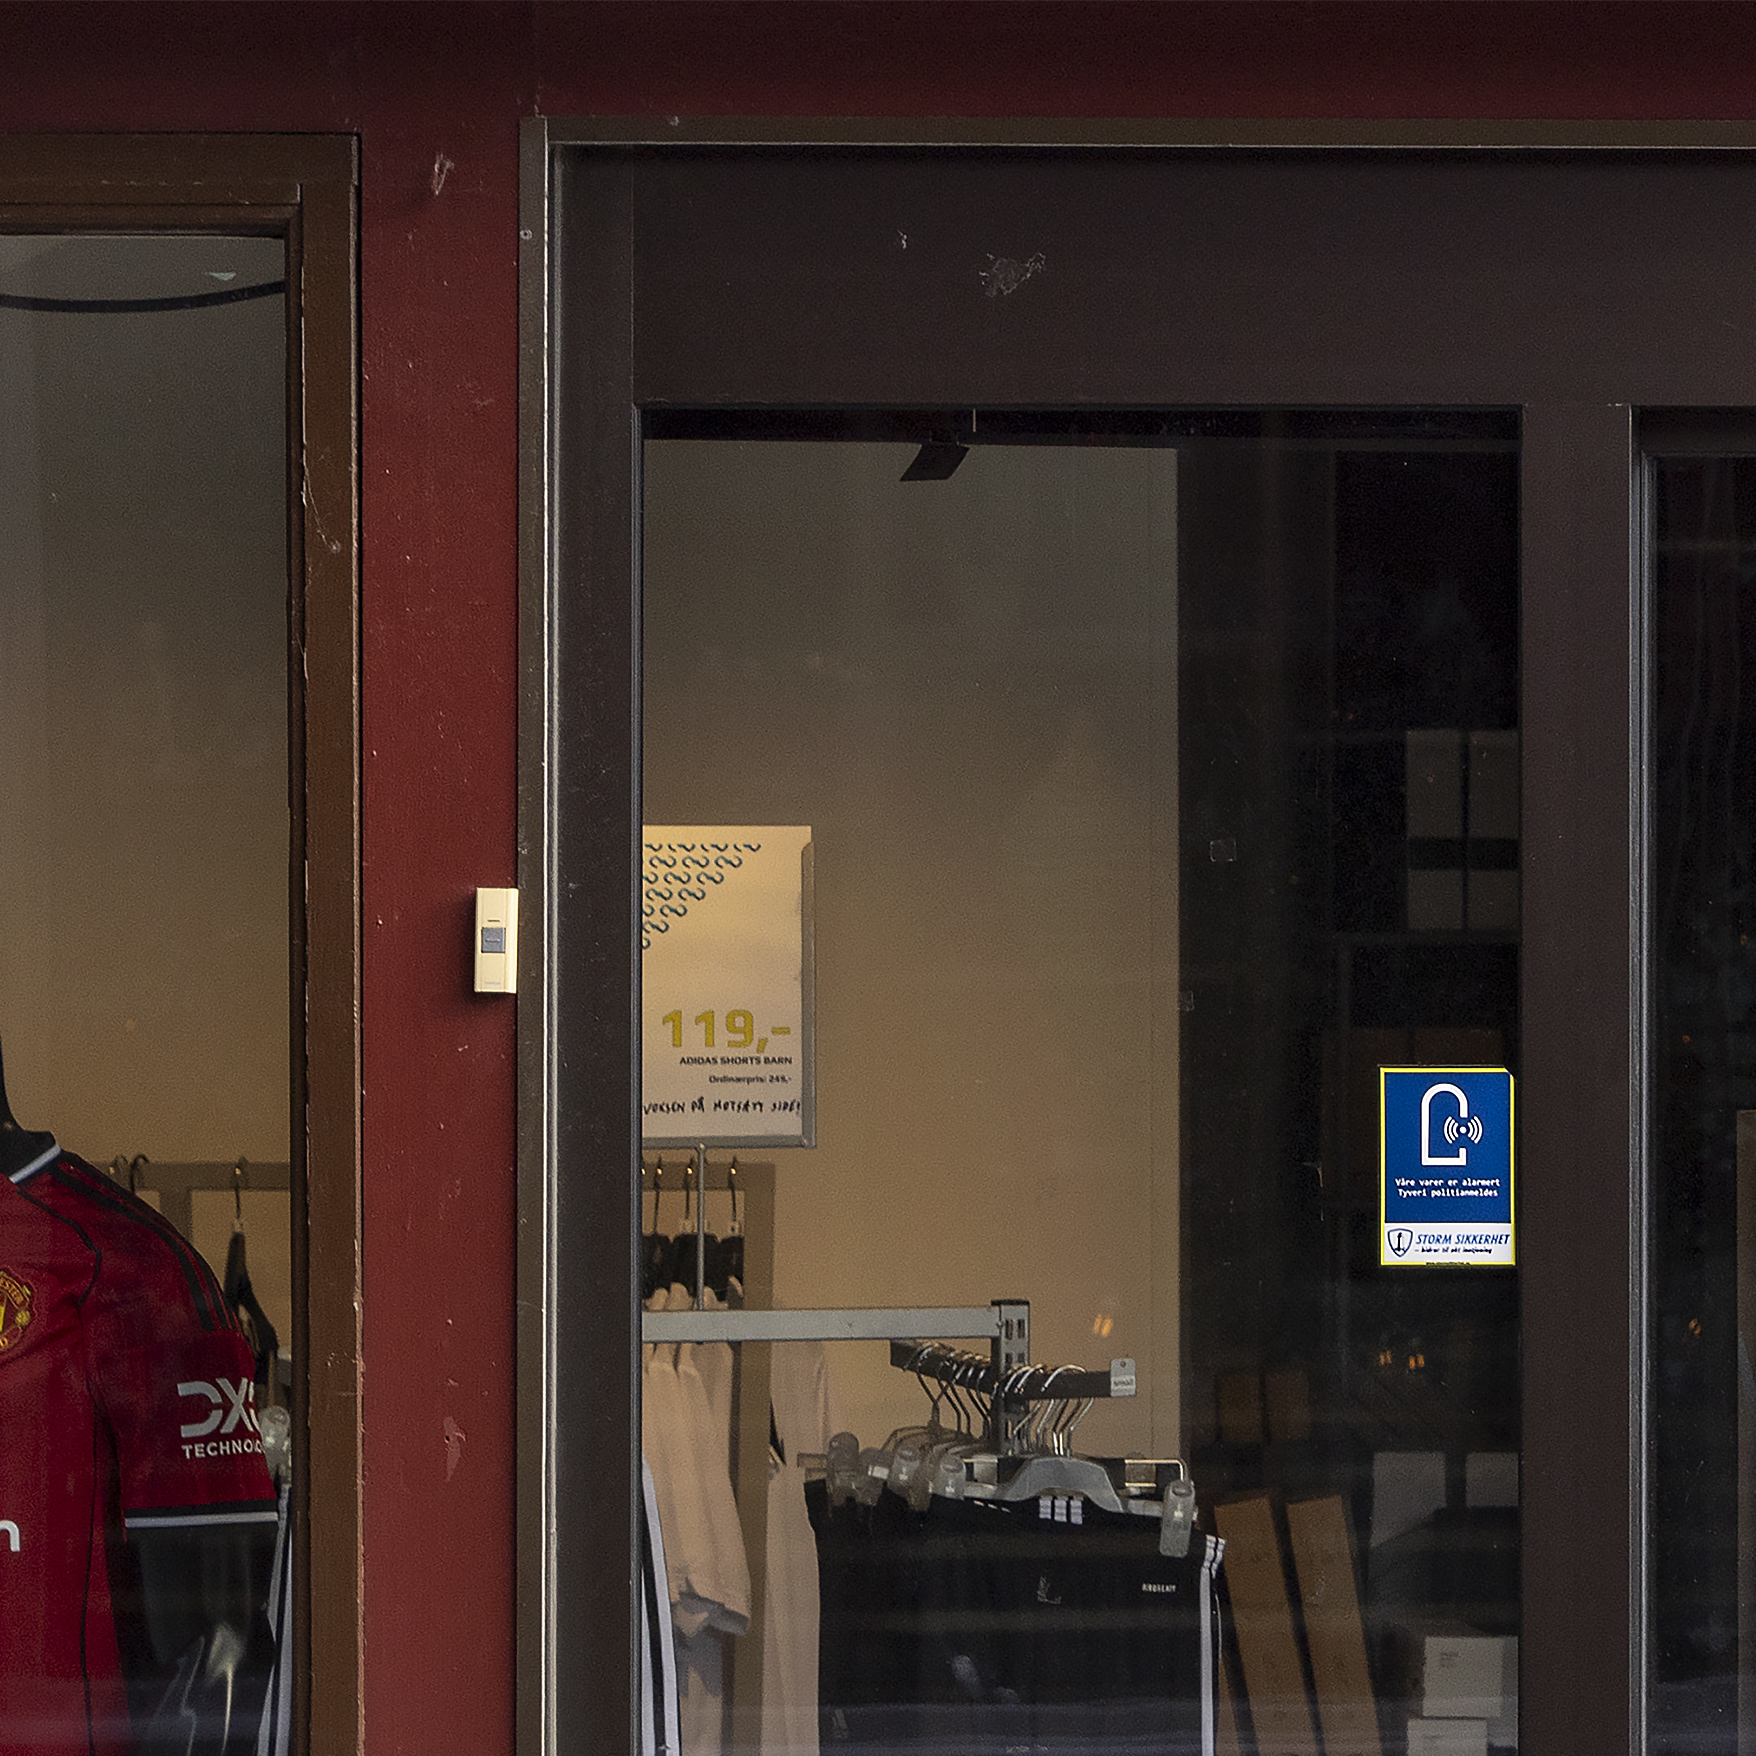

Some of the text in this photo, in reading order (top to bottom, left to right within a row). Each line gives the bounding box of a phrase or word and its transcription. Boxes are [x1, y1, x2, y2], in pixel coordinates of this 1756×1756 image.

[662, 1009, 791, 1053] 119,-
[679, 1055, 793, 1066] ADIDAS SHORTS BARN
[1395, 1177, 1501, 1187] Våre varer er alarmert
[1397, 1188, 1499, 1199] Tyveri politianmeldes
[1416, 1234, 1510, 1244] STORM SIKKERHET
